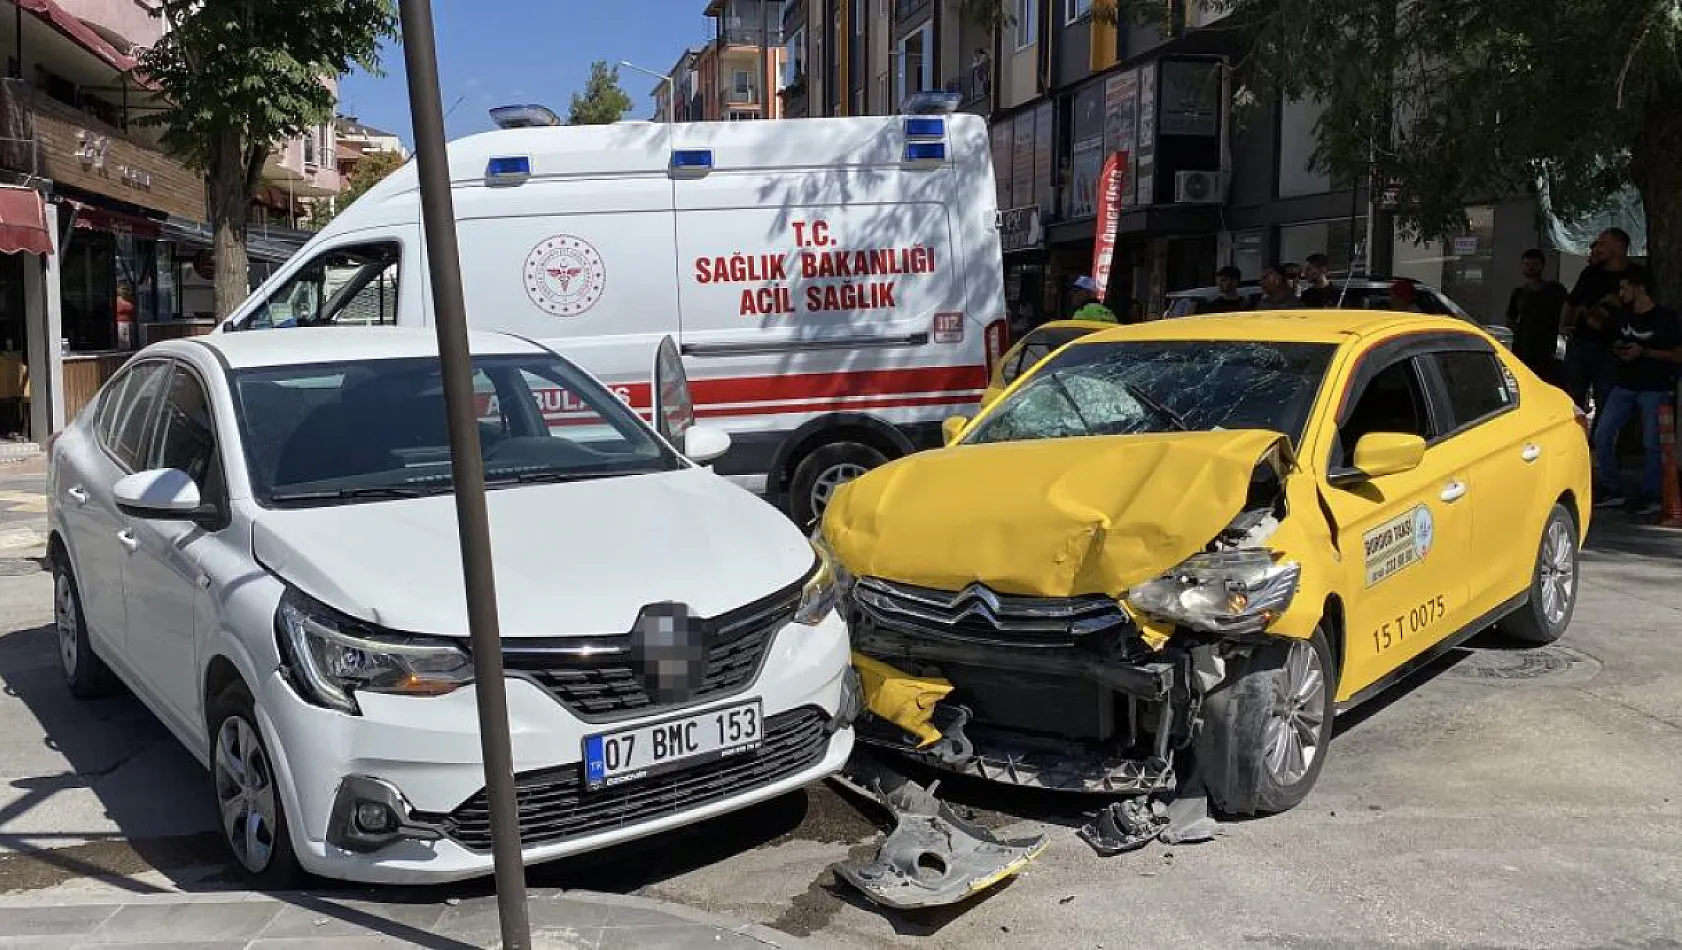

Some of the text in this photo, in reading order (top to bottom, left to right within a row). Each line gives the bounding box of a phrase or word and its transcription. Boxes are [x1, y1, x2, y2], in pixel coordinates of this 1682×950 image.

[792, 220, 837, 247] T.C.
[695, 243, 935, 283] SAĞLIK BAKANLIĞI
[739, 280, 896, 315] ACİL SAĞLIK
[1373, 593, 1445, 654] 15 T 0075
[605, 734, 636, 770] 07
[653, 721, 699, 760] BMC
[716, 708, 756, 745] 153
